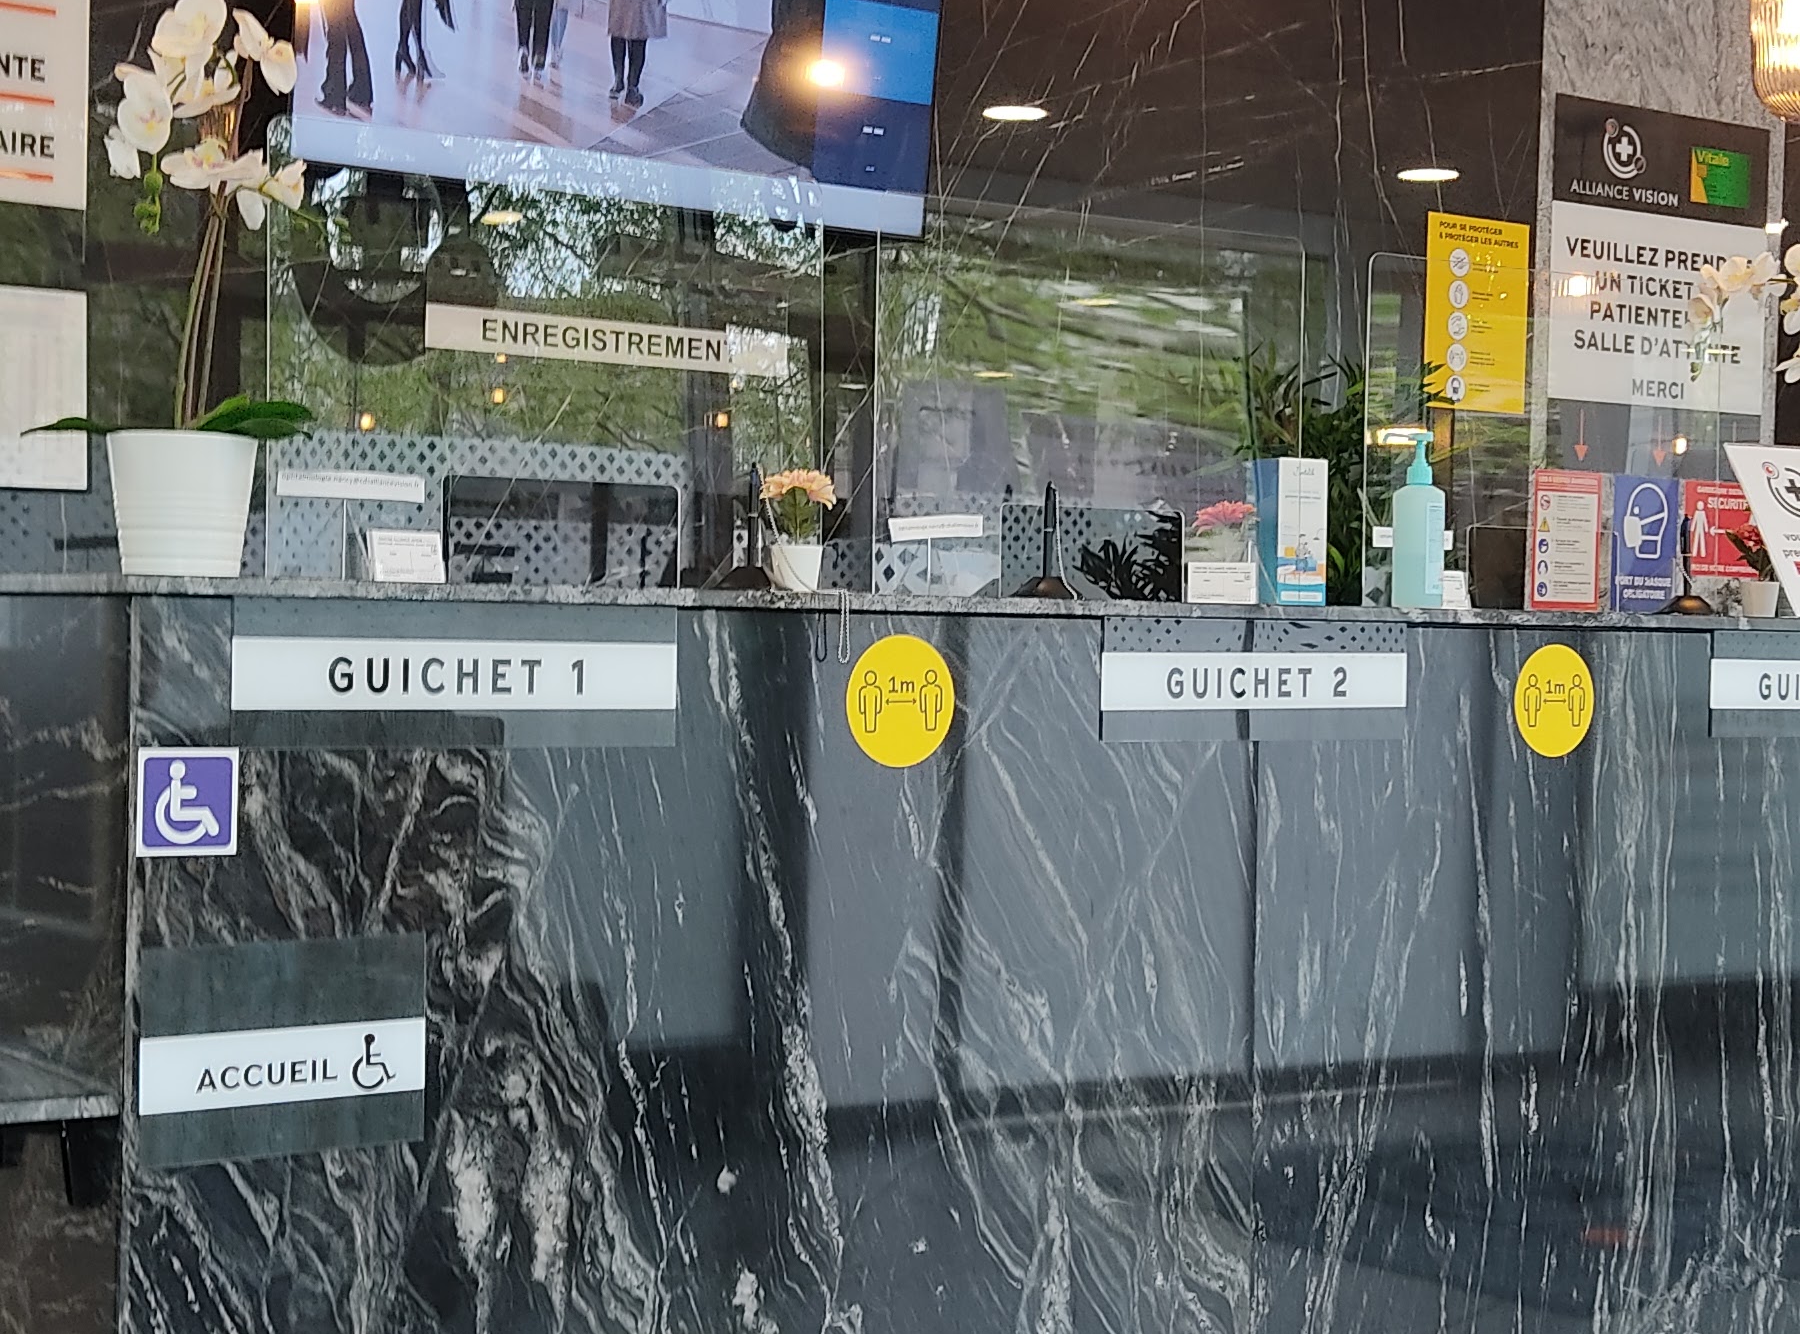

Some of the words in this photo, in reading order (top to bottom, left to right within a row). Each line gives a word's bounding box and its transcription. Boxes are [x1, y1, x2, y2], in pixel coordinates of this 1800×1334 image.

[1696, 149, 1730, 167] Vitale
[1569, 178, 1630, 200] ALLIANCE
[1632, 187, 1679, 207] VISION
[1439, 220, 1457, 230] POUR
[1480, 236, 1493, 246] LES
[1494, 238, 1519, 249] AUTRES
[1565, 235, 1659, 267] VEUILLEZ
[1595, 270, 1621, 293] UN
[1627, 274, 1694, 301] TICKET
[1589, 300, 1690, 329] PATIENTE
[481, 318, 737, 364] ENREGISTREMEN
[1574, 329, 1635, 355] SALLE
[1632, 378, 1685, 400] MERCI
[328, 656, 542, 695] GUICHET
[571, 658, 585, 695] 1
[888, 675, 915, 694] 1m
[1166, 666, 1312, 699] GUICHET
[1332, 666, 1348, 698] 2
[1545, 678, 1565, 695] 1m
[1759, 672, 1800, 701] GUI
[195, 1058, 338, 1094] ACCUEIL
